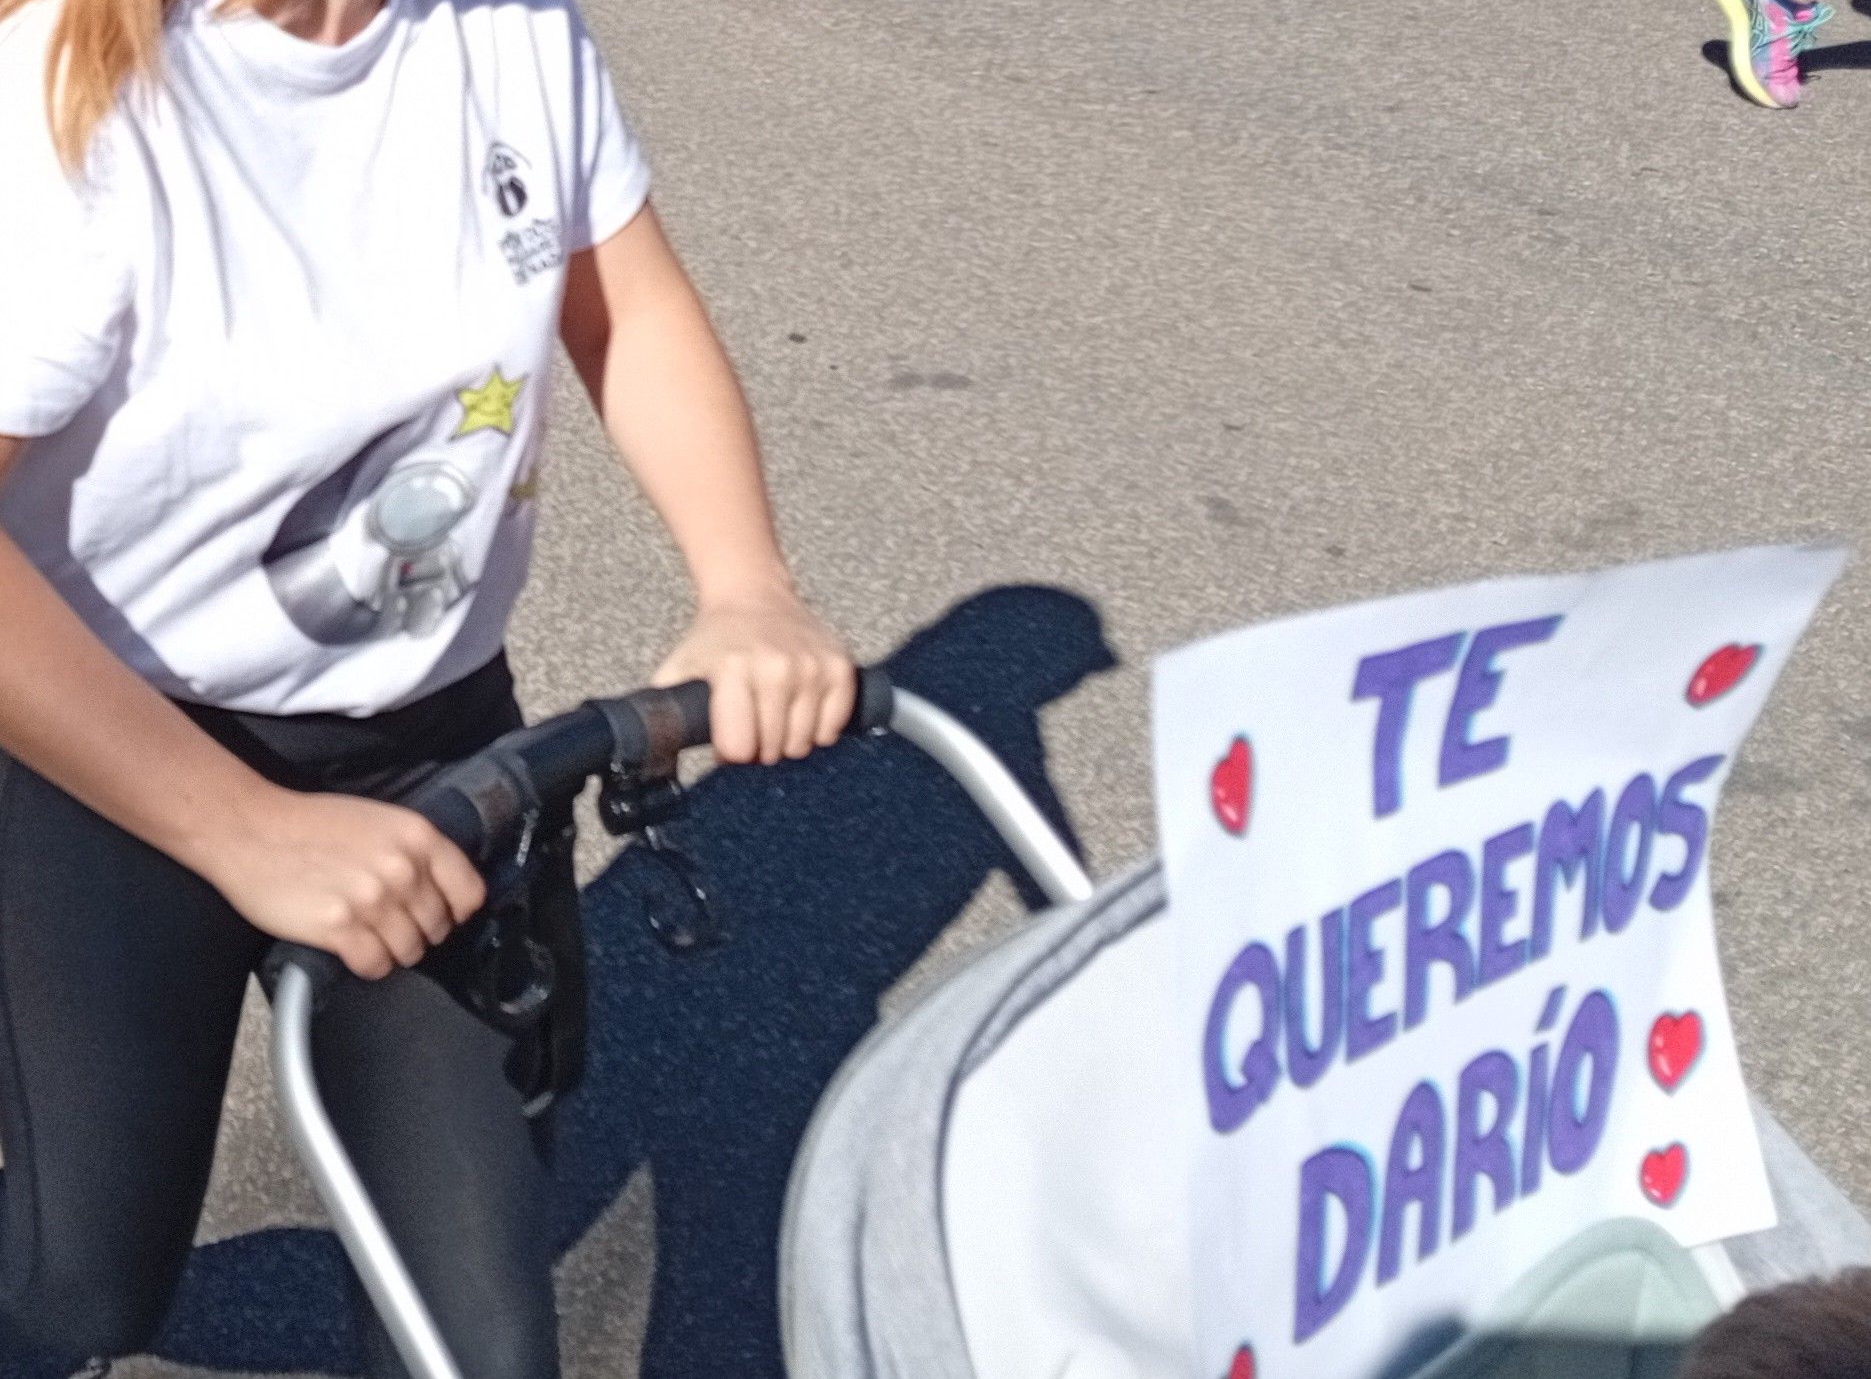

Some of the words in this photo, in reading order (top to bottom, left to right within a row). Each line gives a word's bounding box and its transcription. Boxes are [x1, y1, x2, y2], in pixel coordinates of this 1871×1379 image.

[1350, 614, 1568, 820] TE
[1203, 753, 1727, 1135] QUEREMOS
[1293, 984, 1619, 1345] DARÍO
